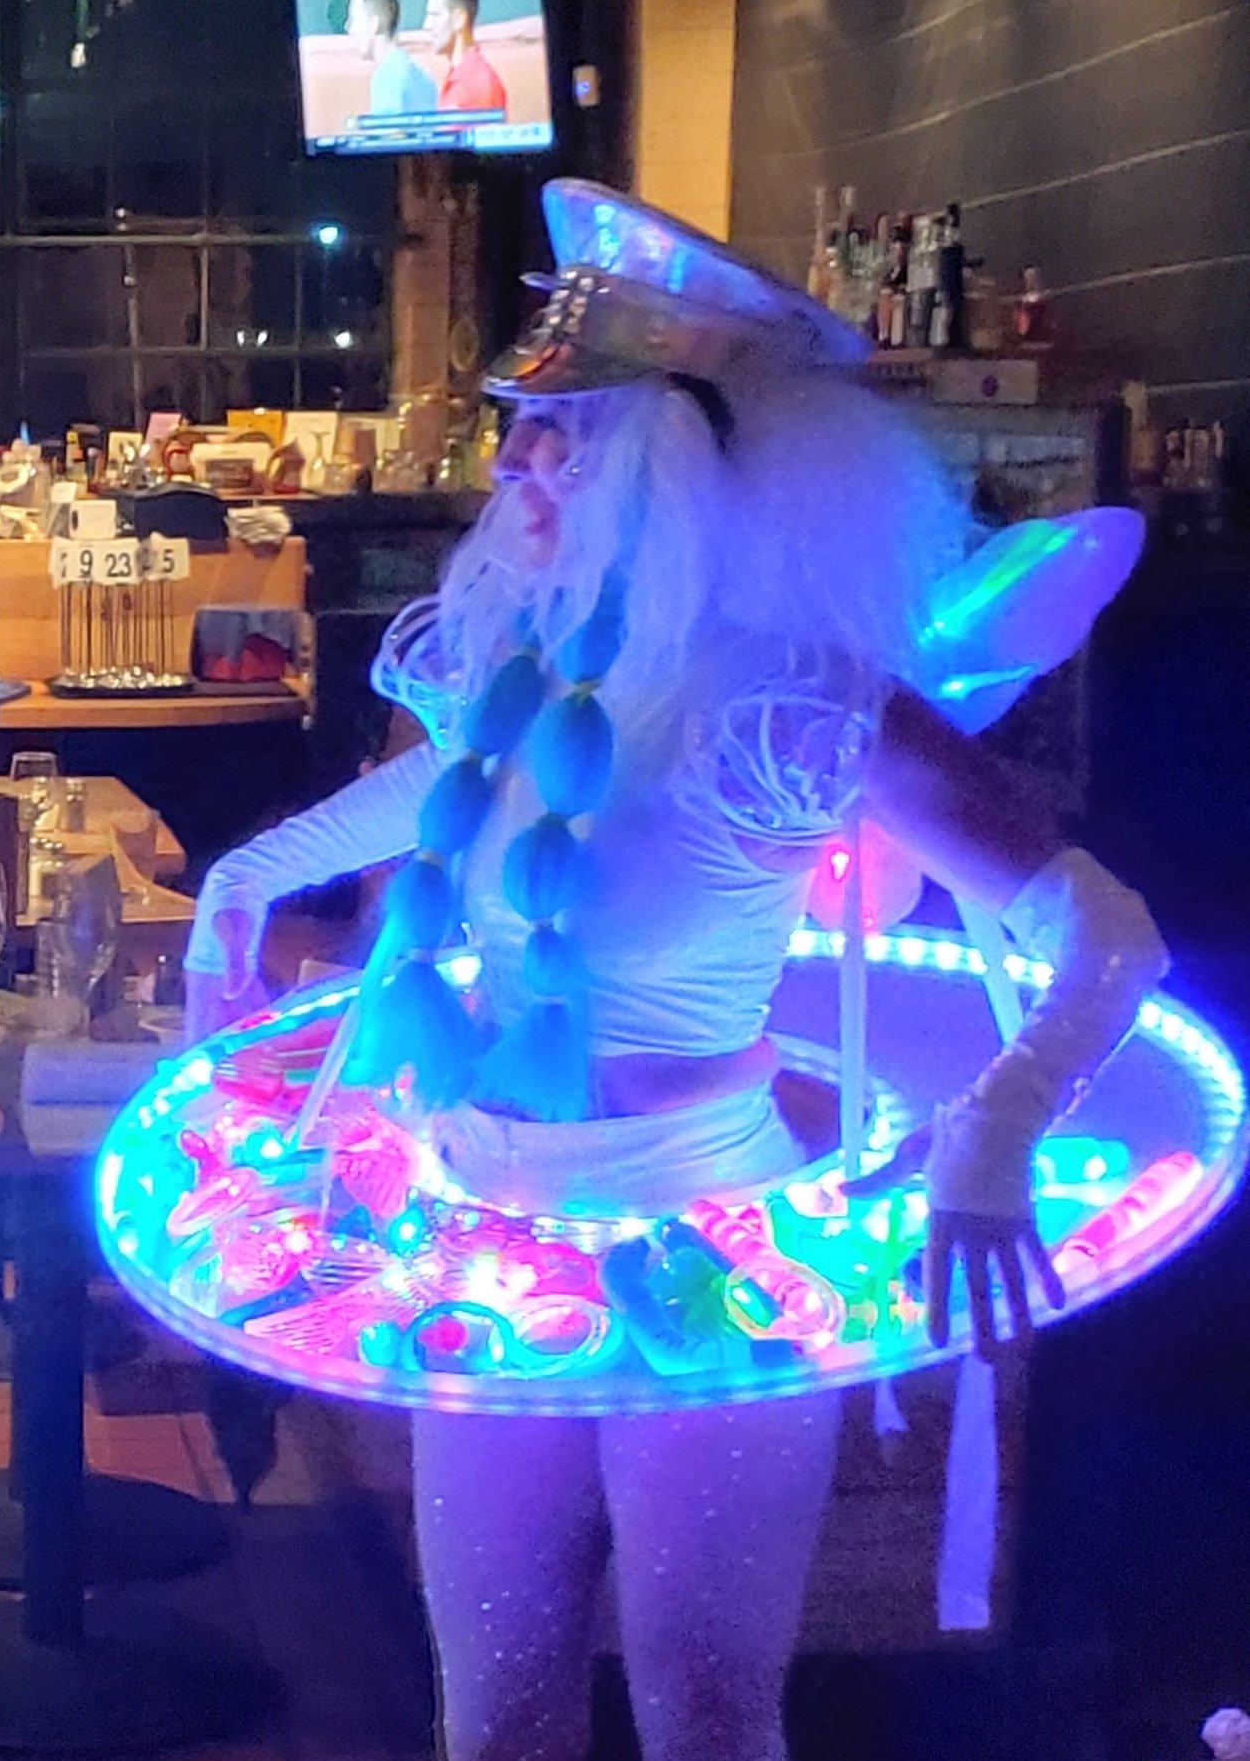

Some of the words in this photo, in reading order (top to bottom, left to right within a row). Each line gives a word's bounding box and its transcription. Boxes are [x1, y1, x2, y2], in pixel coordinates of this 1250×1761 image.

[80, 549, 93, 578] 9
[105, 551, 132, 577] 23
[163, 548, 175, 573] 5
